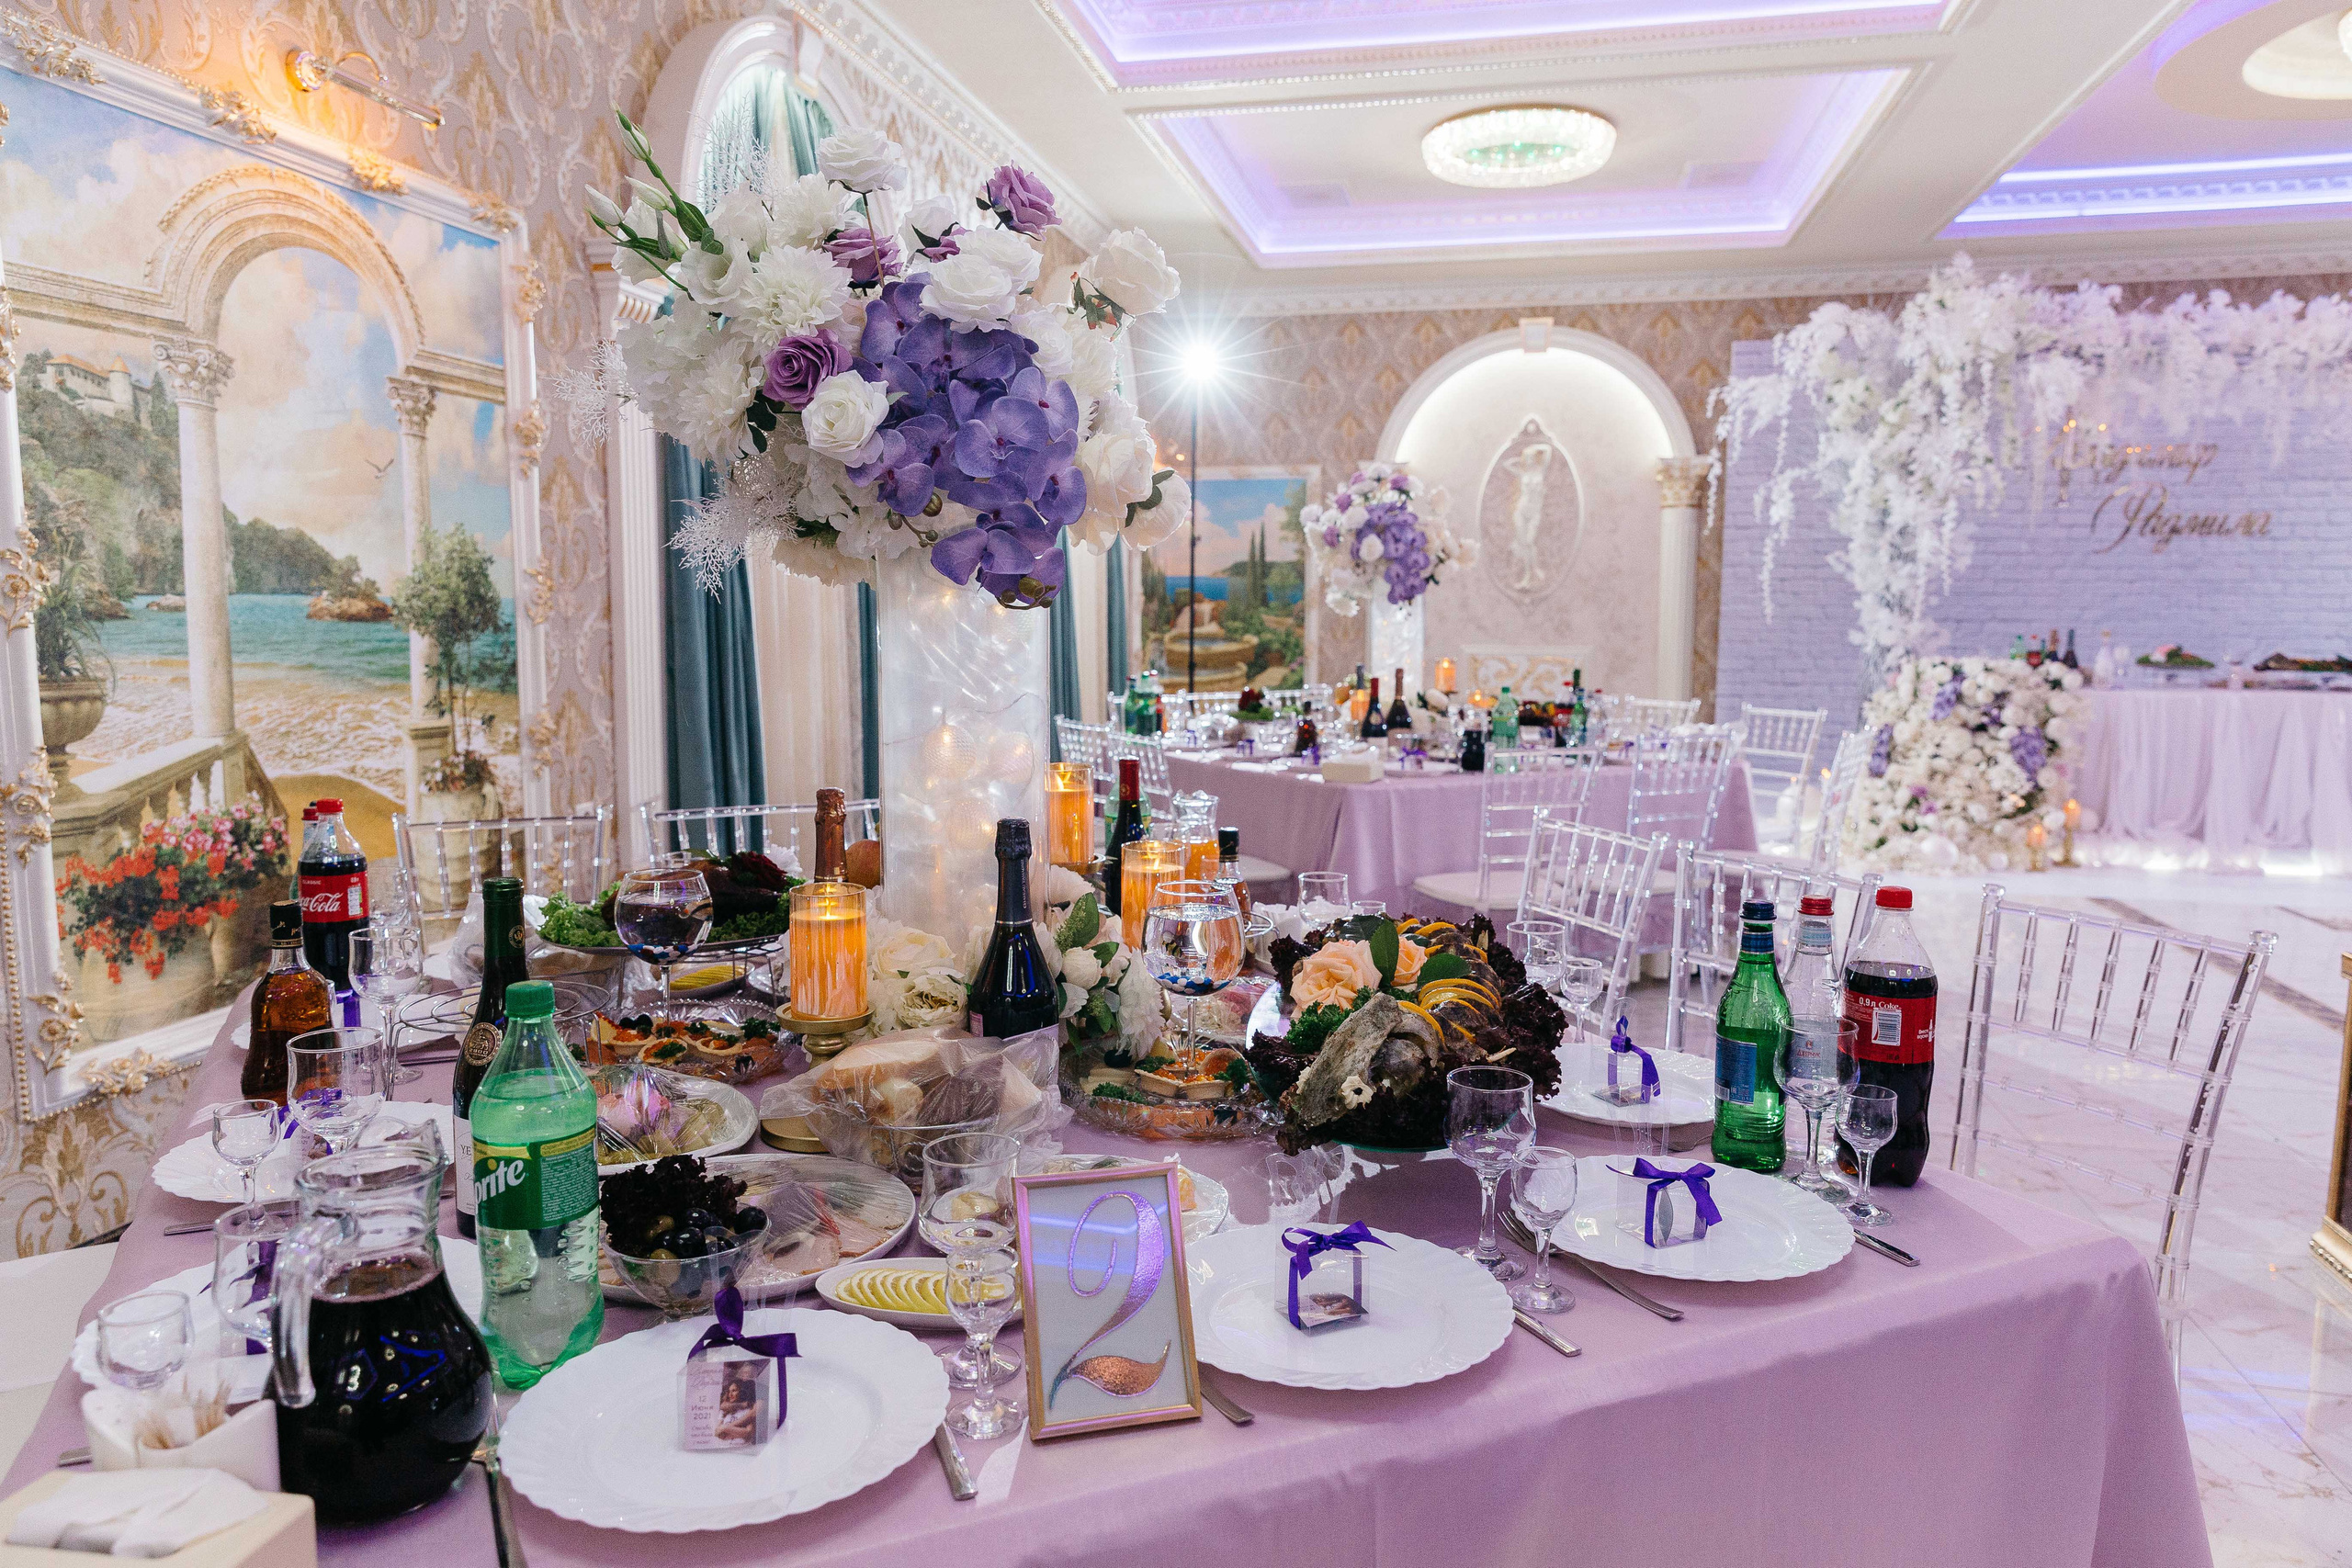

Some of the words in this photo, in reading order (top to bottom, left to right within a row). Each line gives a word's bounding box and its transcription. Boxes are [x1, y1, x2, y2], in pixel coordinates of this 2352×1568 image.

[1878, 1001, 1899, 1010] Coke
[474, 1159, 526, 1214] prite
[1049, 1190, 1171, 1409] 2
[693, 1412, 711, 1420] 2021
